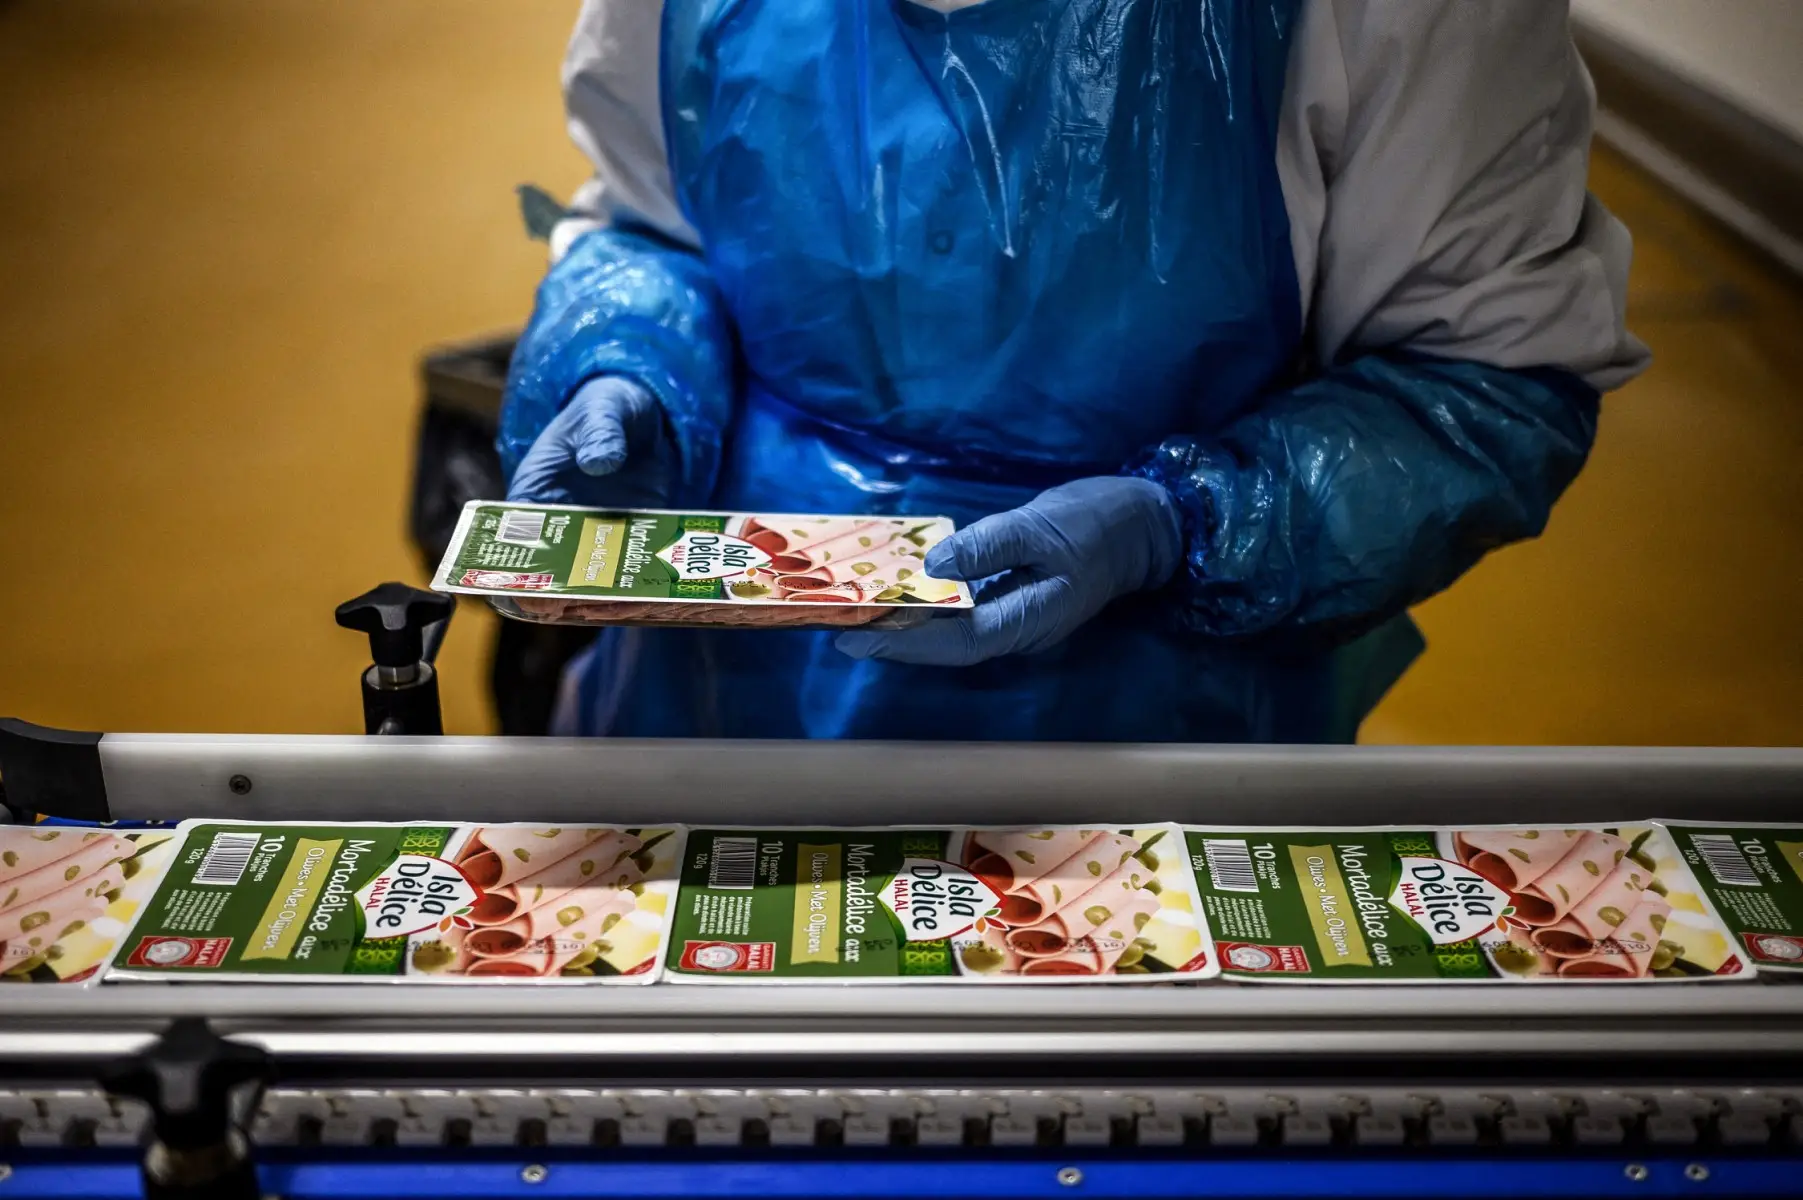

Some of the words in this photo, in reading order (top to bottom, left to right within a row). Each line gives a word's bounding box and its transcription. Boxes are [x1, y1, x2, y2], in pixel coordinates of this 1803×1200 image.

[549, 515, 571, 525] 10
[622, 519, 658, 573] Mortadélice
[671, 545, 686, 564] HALAL
[686, 536, 720, 573] Délice
[722, 544, 756, 567] Isla
[184, 847, 205, 864] 120g
[260, 835, 285, 852] 10
[761, 841, 783, 854] 10
[249, 852, 265, 872] Plakjes
[253, 853, 276, 882] Tranches
[297, 847, 325, 880] Olives
[693, 853, 707, 869] 120g
[759, 856, 769, 876] Plakjes
[768, 856, 780, 885] Tranches
[811, 853, 828, 883] Olives
[1192, 854, 1205, 870] 120g
[1252, 843, 1276, 859] 10
[1266, 860, 1281, 889] Tranches
[1256, 860, 1268, 879] Plakjes
[1306, 856, 1327, 887] Olives
[1740, 838, 1765, 854] 10
[1758, 856, 1783, 883] Tranches
[283, 888, 308, 909] Met
[309, 839, 376, 931] Mortadélice
[365, 877, 390, 911] HALAL
[376, 861, 431, 927] Délice
[418, 875, 463, 915] Isla
[810, 891, 828, 911] Met
[846, 844, 874, 933] Mortadélice
[895, 879, 908, 912] HALAL
[911, 864, 946, 931] Délice
[948, 878, 983, 917] Isla
[1400, 883, 1424, 917] HALAL
[1411, 863, 1460, 934] Délice
[1453, 876, 1495, 916] Isla
[1319, 895, 1336, 916] Met
[1337, 844, 1389, 938] Mortadélice
[1372, 943, 1394, 966] aux
[262, 910, 296, 950] Olijven
[804, 913, 826, 954] Olijven
[1325, 918, 1350, 956] Olijven
[295, 935, 317, 960] aux
